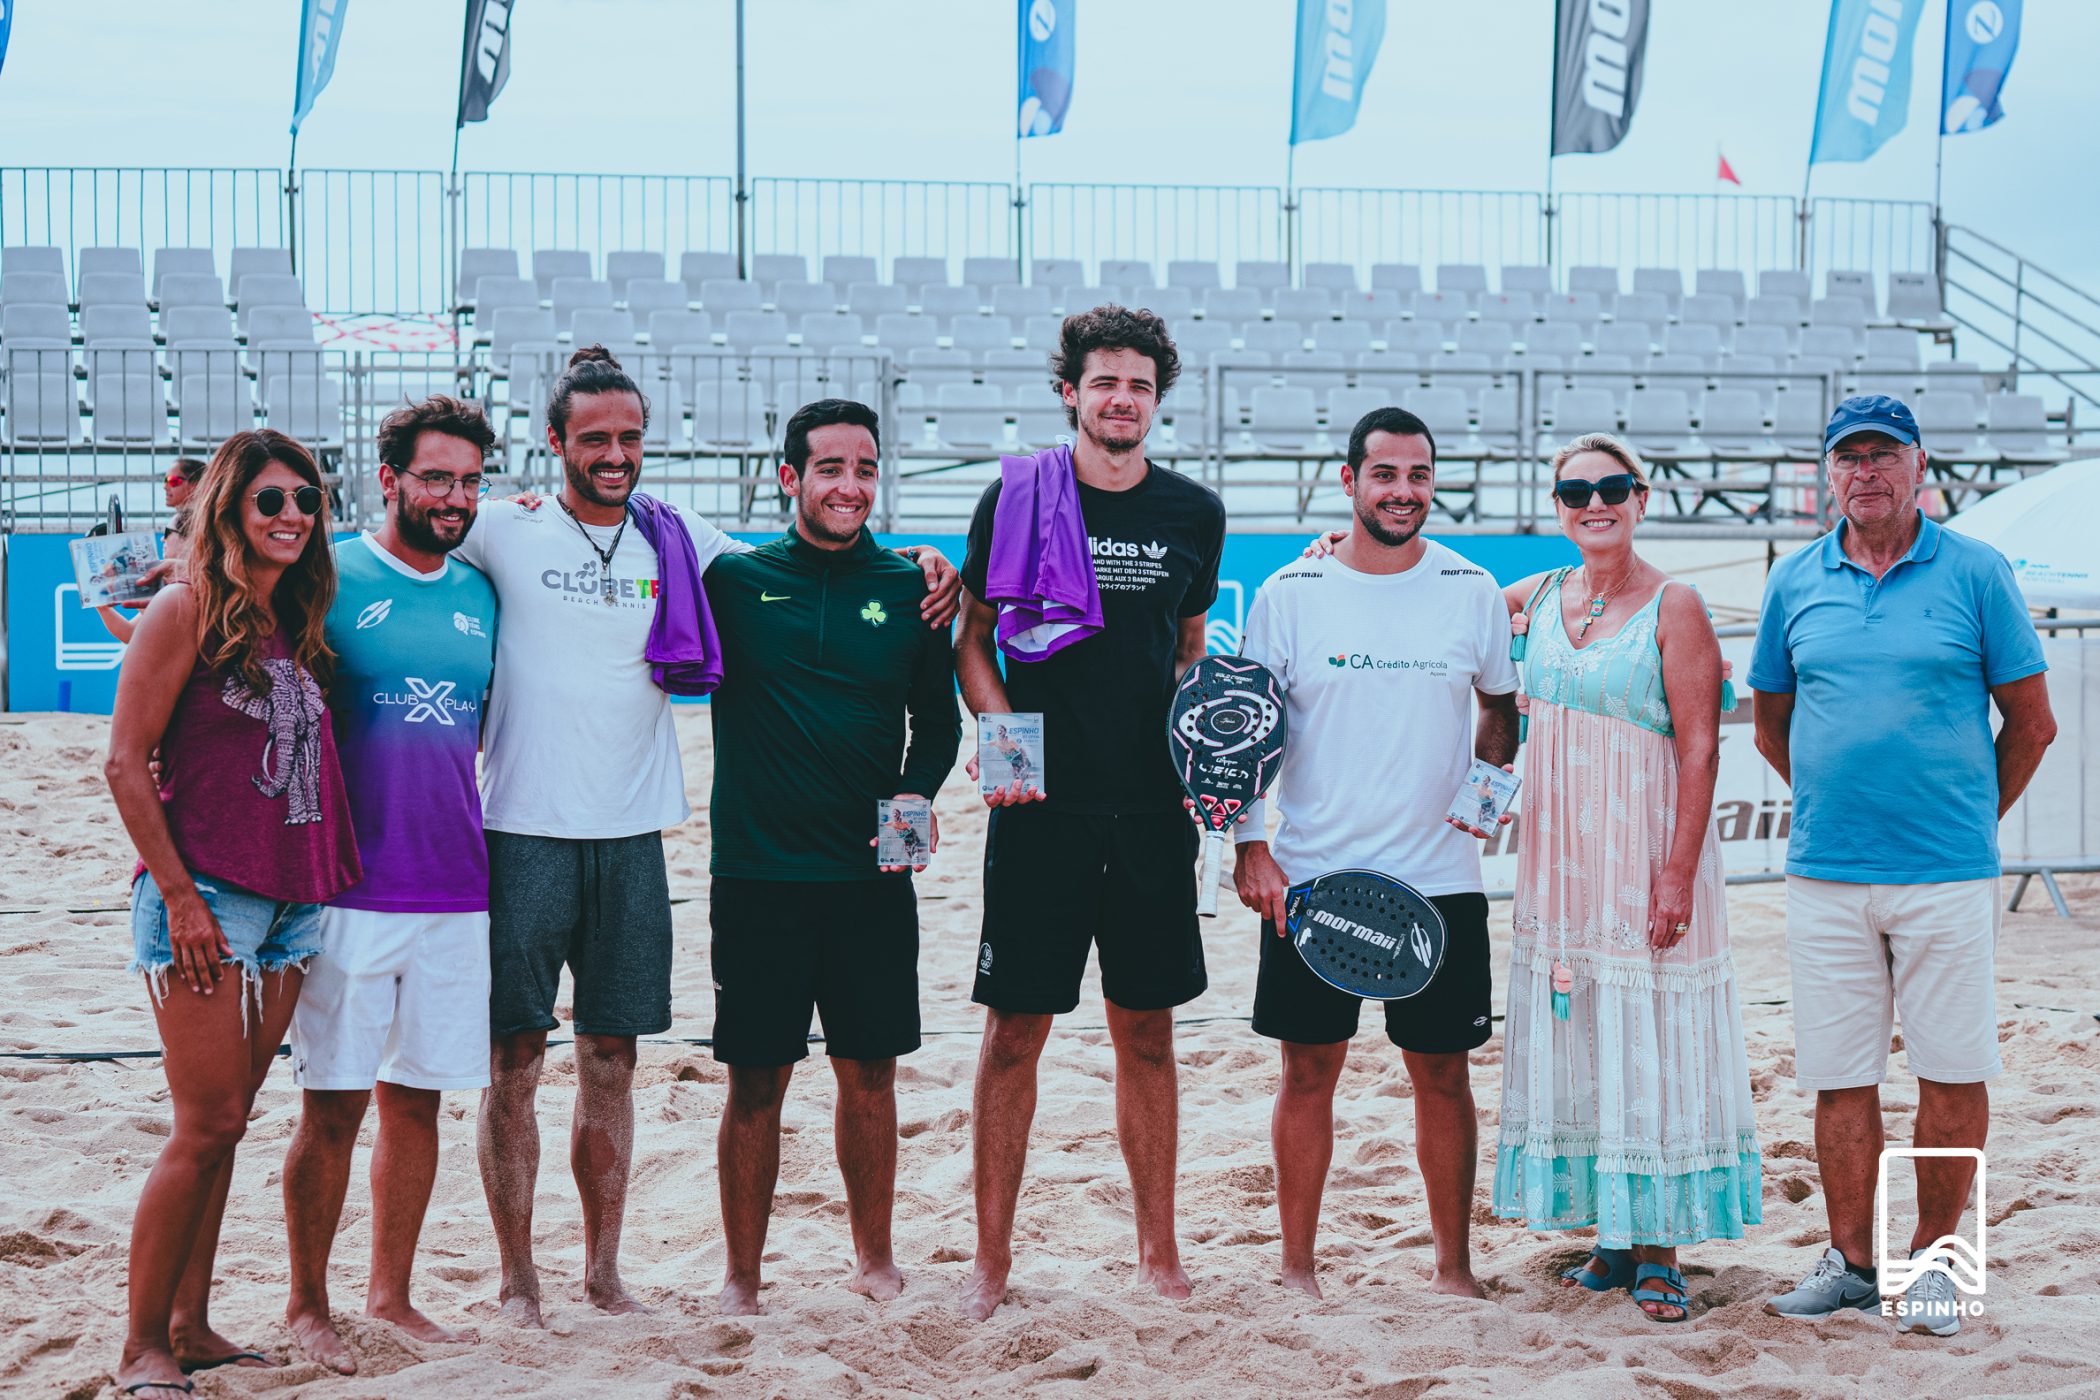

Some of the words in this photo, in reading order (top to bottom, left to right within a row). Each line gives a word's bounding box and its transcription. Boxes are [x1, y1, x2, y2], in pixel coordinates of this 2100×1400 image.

[1142, 569, 1169, 577] STREIFEN
[563, 595, 599, 606] BEACH
[1350, 653, 1374, 670] CA
[1376, 659, 1410, 669] Crédito
[1412, 659, 1448, 670] Agrícola
[1009, 727, 1040, 735] ESPINHO
[1312, 910, 1398, 950] mormaii
